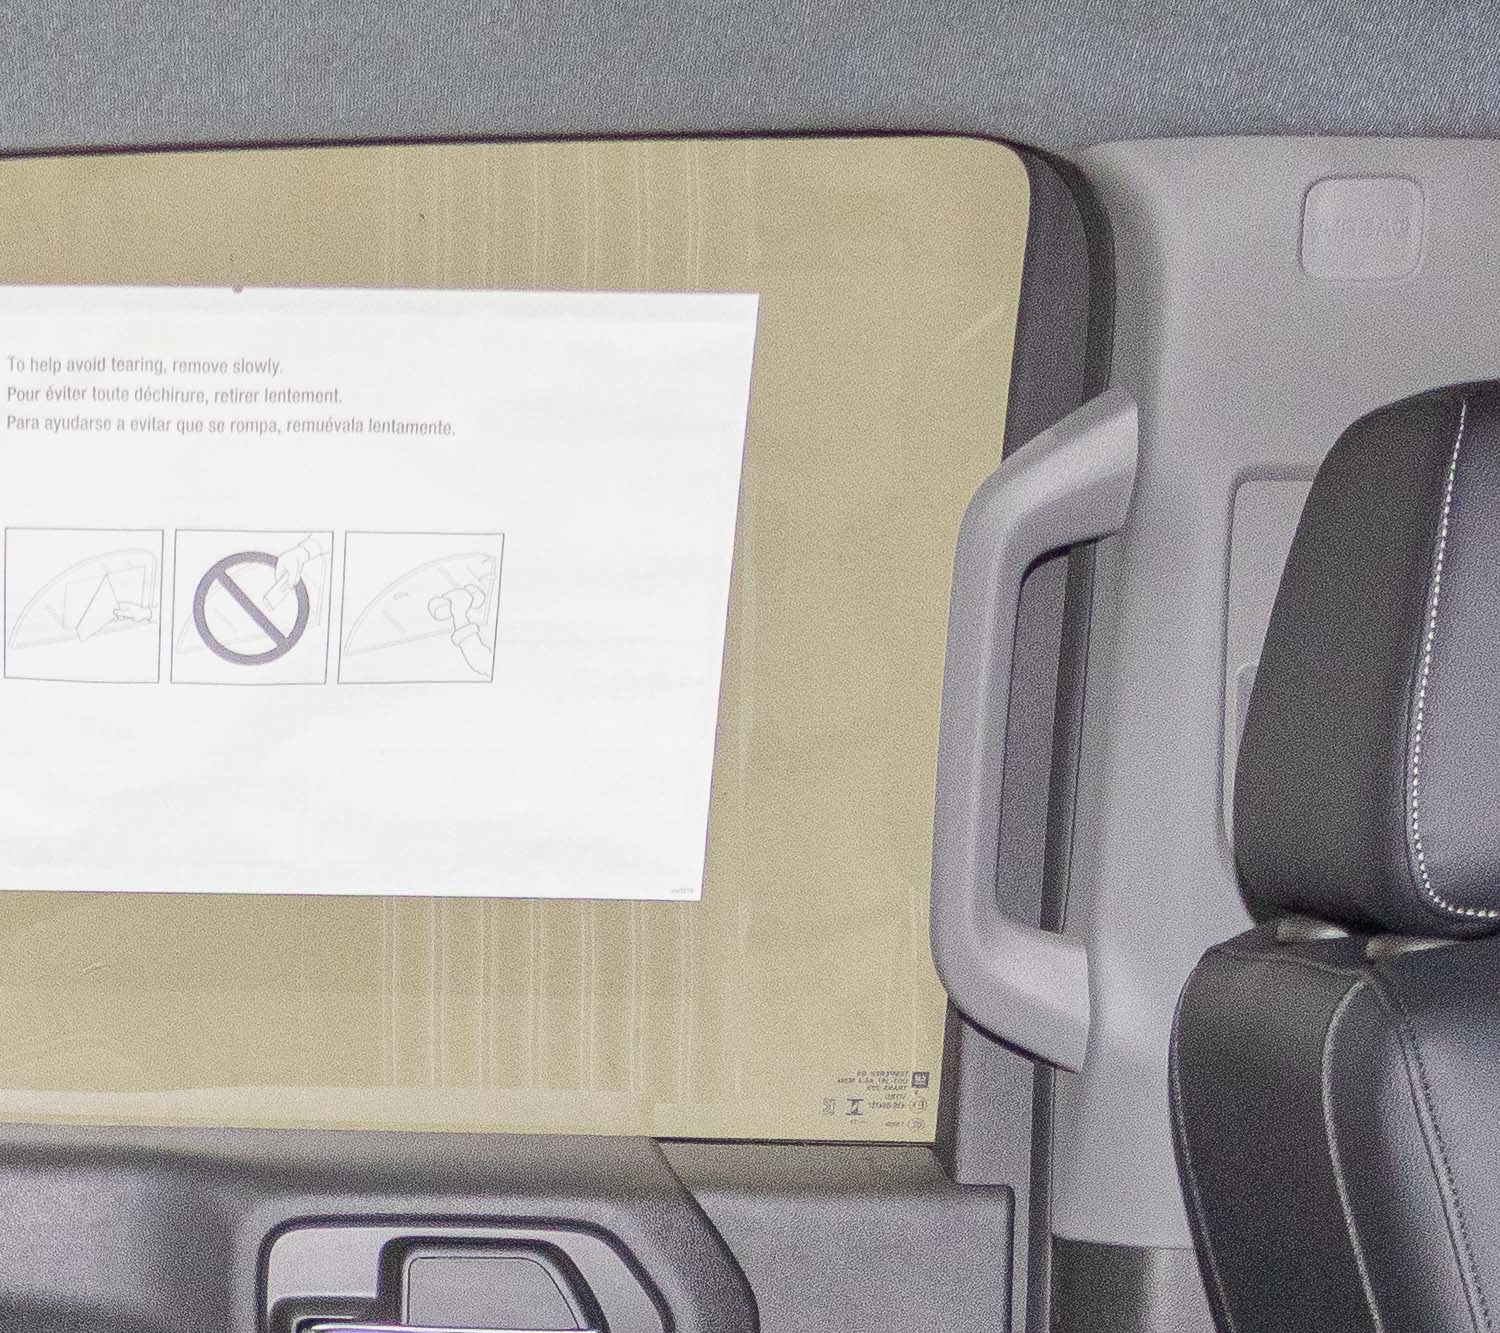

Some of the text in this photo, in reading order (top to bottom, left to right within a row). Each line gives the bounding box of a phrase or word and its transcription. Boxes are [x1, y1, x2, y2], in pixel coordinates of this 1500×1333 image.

[8, 356, 283, 376] To help avoid tearing, remove slowly.
[8, 386, 342, 405] Pour éviter toute déchirure, retirer lentement.
[7, 416, 455, 436] Para ayudarse a evitar que se rompa, remuévala lentamente.
